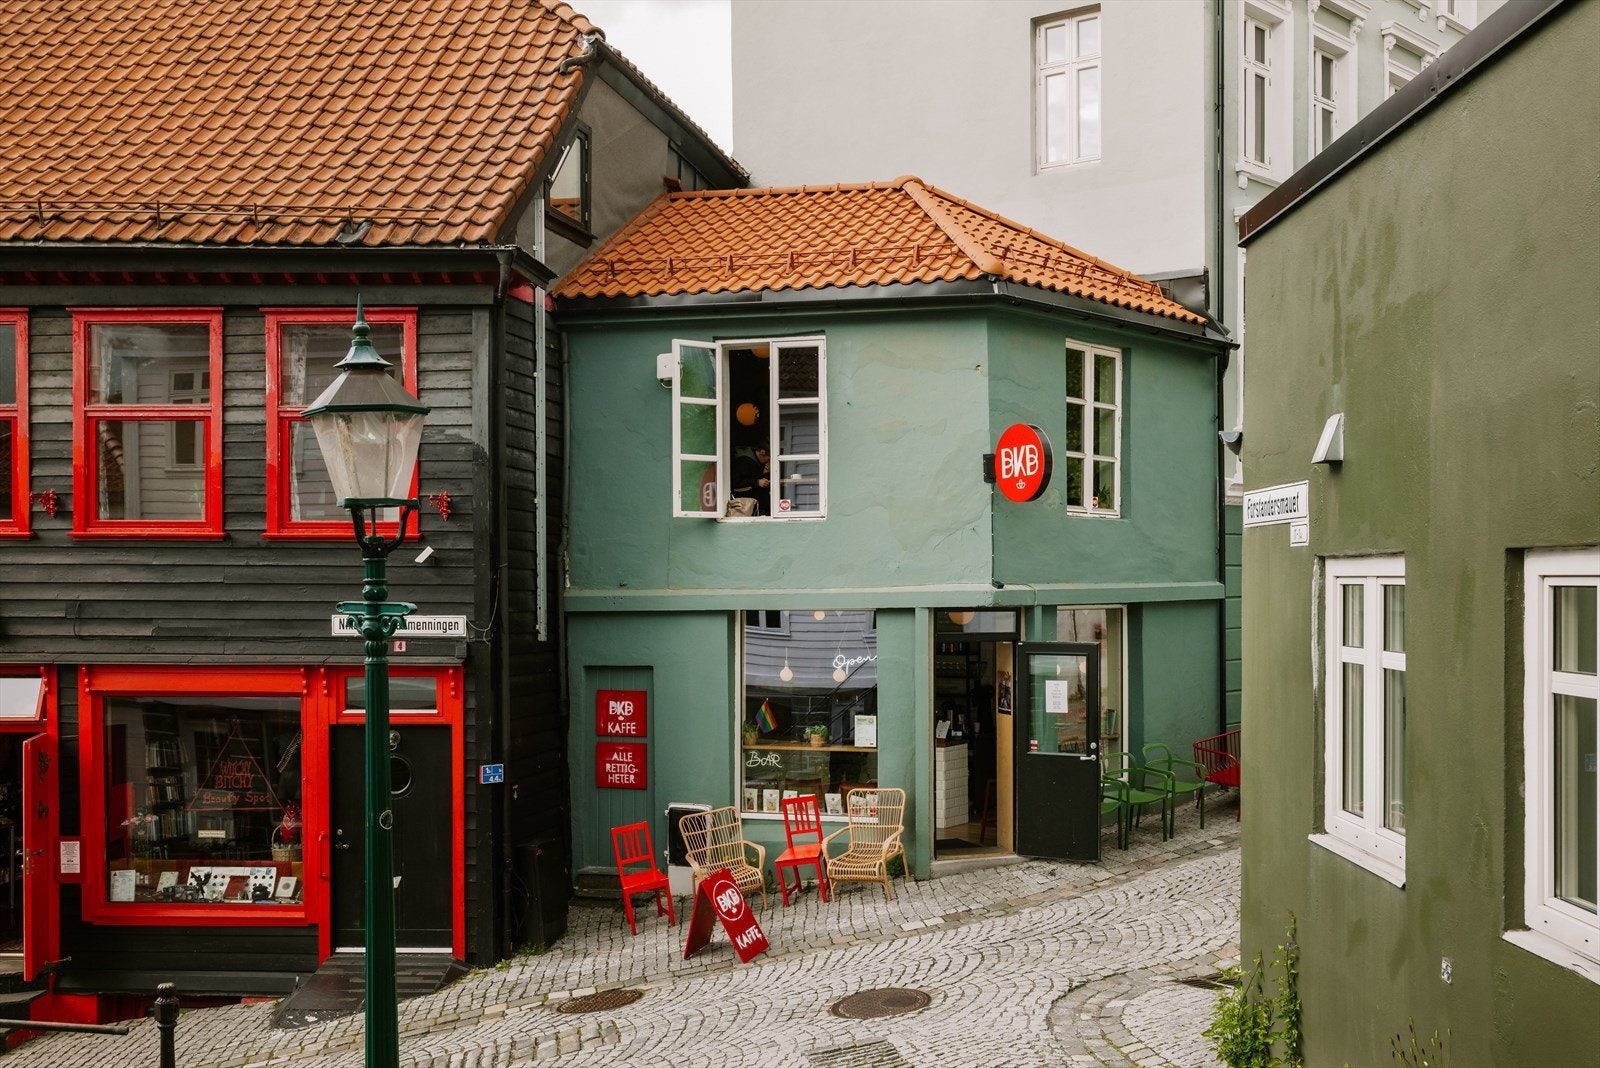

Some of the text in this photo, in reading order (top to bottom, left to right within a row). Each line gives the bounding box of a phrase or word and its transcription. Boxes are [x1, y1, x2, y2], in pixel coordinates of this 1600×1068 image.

[1001, 444, 1039, 479] BKB
[1247, 491, 1299, 519] Forstandersmauet
[832, 654, 877, 675] Open
[608, 701, 634, 716] BKB
[607, 722, 636, 734] KAFFE
[611, 752, 633, 762] ALLE
[605, 763, 639, 774] RETTIG-
[214, 774, 255, 789] BITCHY
[608, 774, 635, 784] HETER
[202, 791, 271, 805] Beauty Spot
[716, 888, 740, 912] BKB
